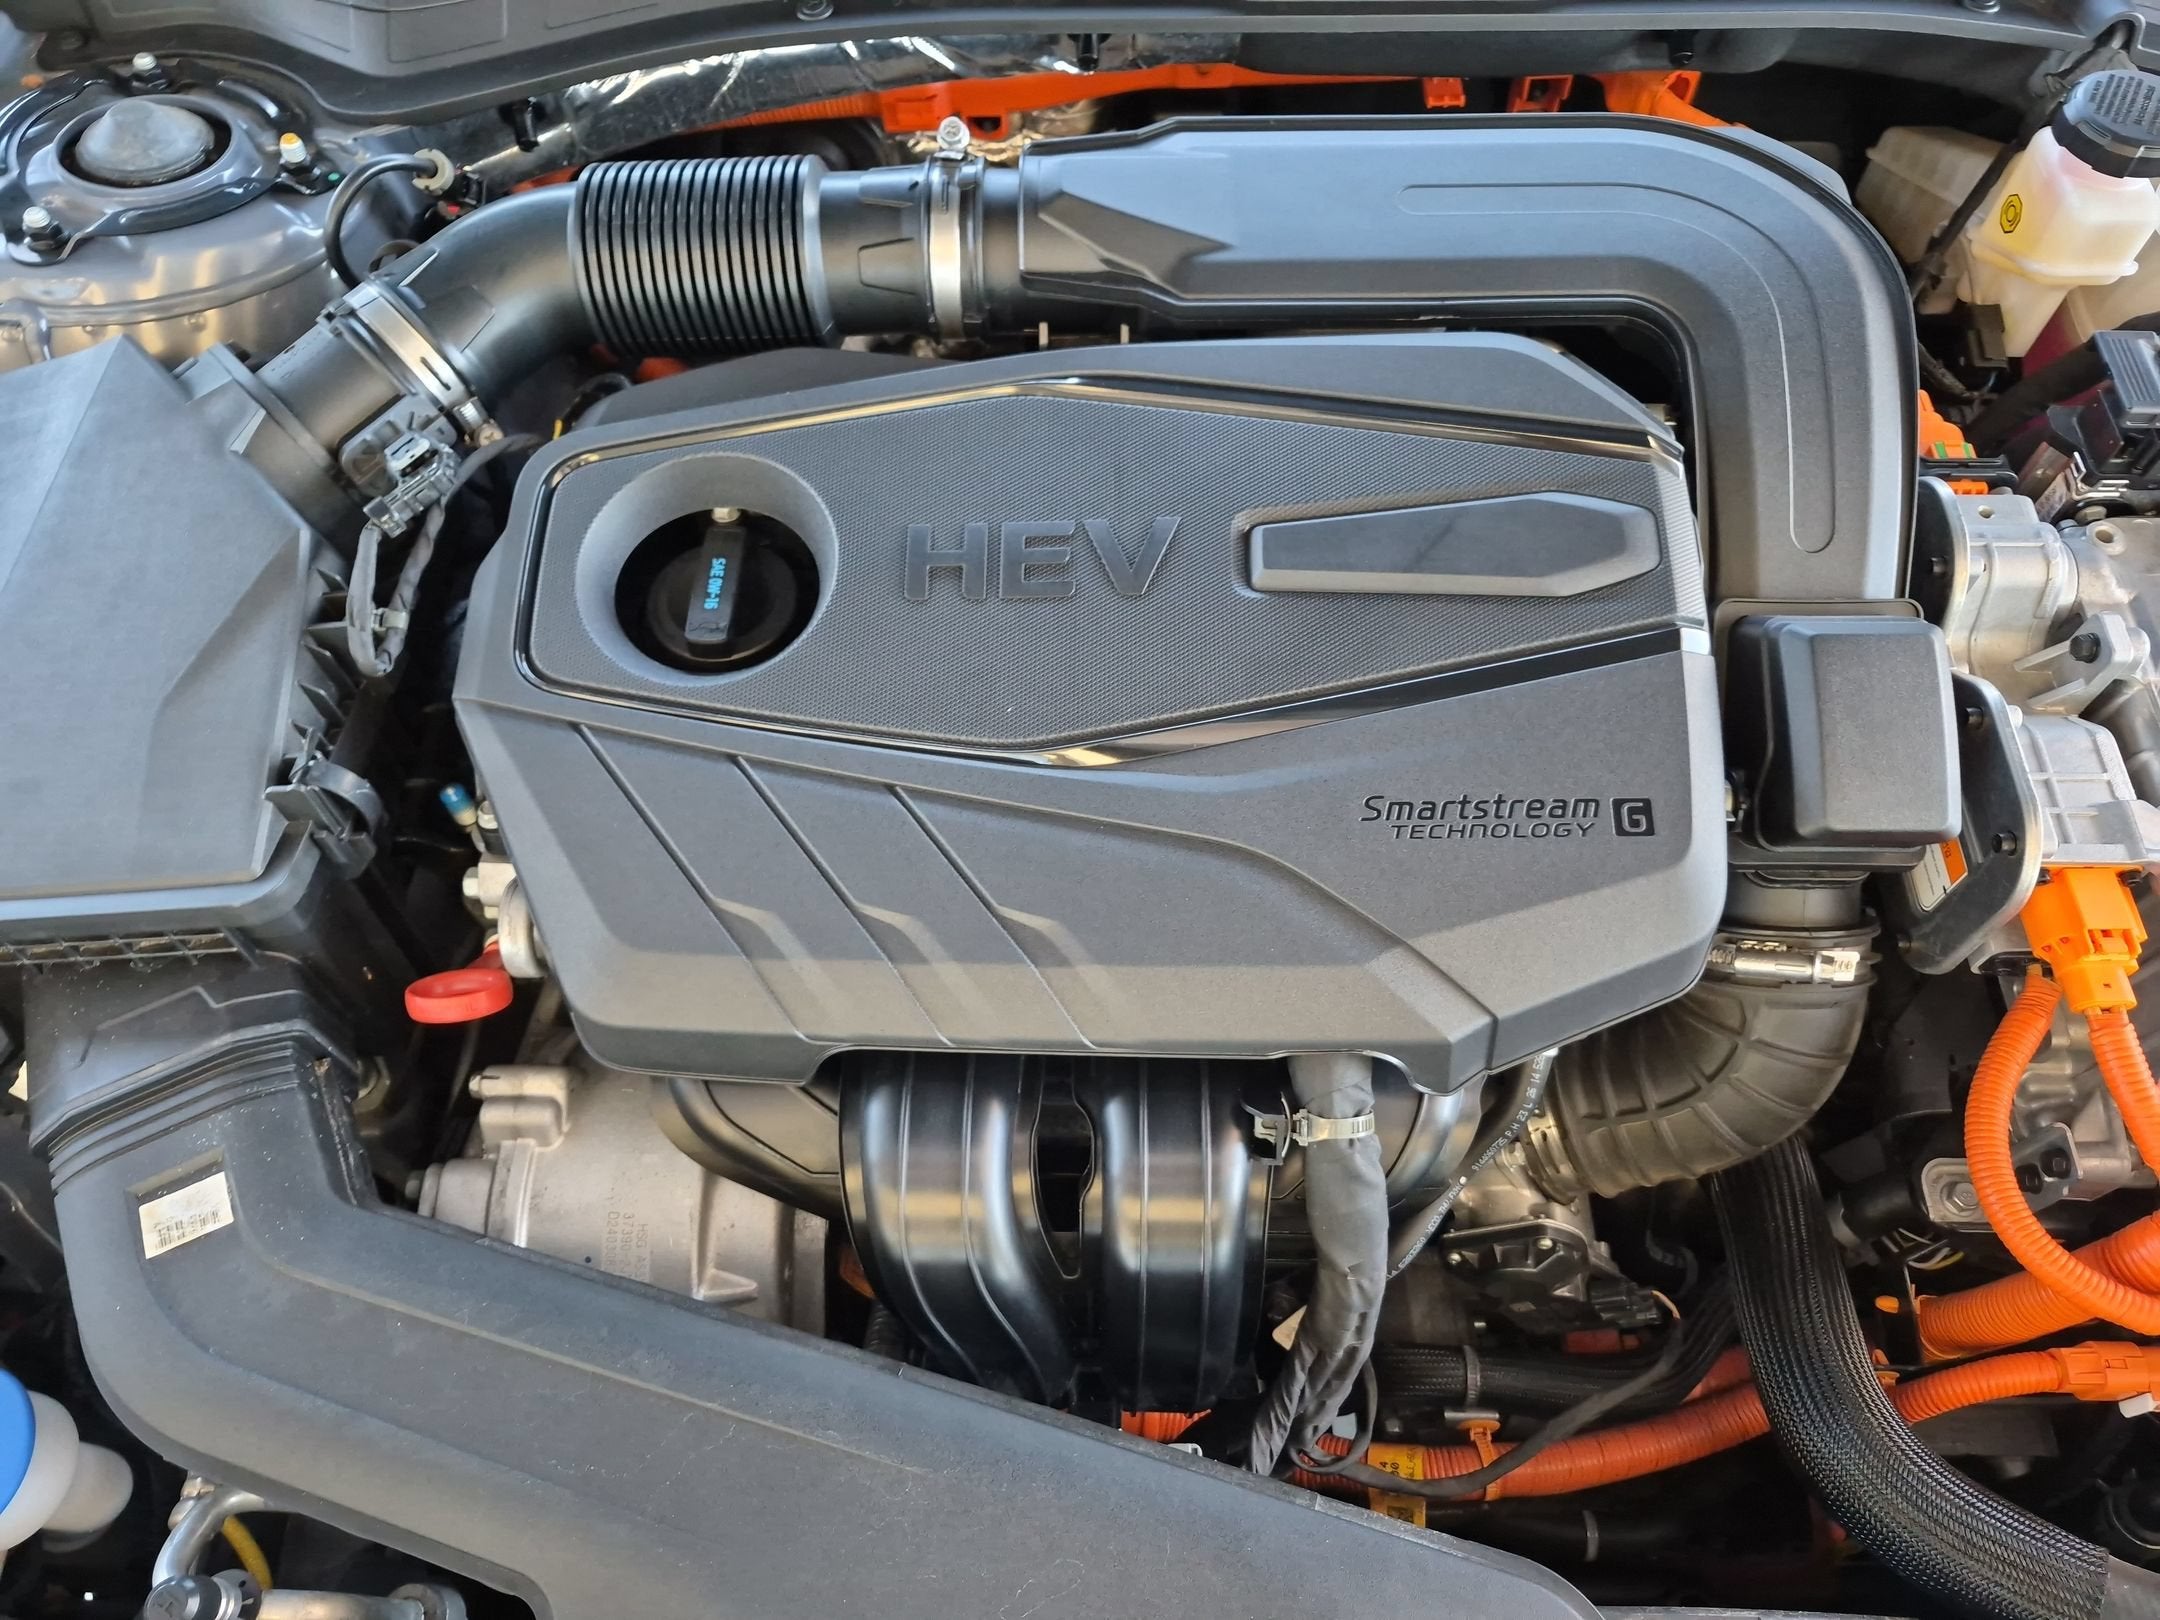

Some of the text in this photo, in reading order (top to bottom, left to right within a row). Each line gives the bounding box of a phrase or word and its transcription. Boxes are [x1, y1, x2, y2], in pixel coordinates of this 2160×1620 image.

[904, 516, 1182, 600] HEV
[704, 557, 726, 609] SAE 0W-16
[1359, 793, 1653, 836] Smartstream G
[1389, 821, 1596, 840] TECHNOLOGY
[636, 1223, 648, 1249] HSG
